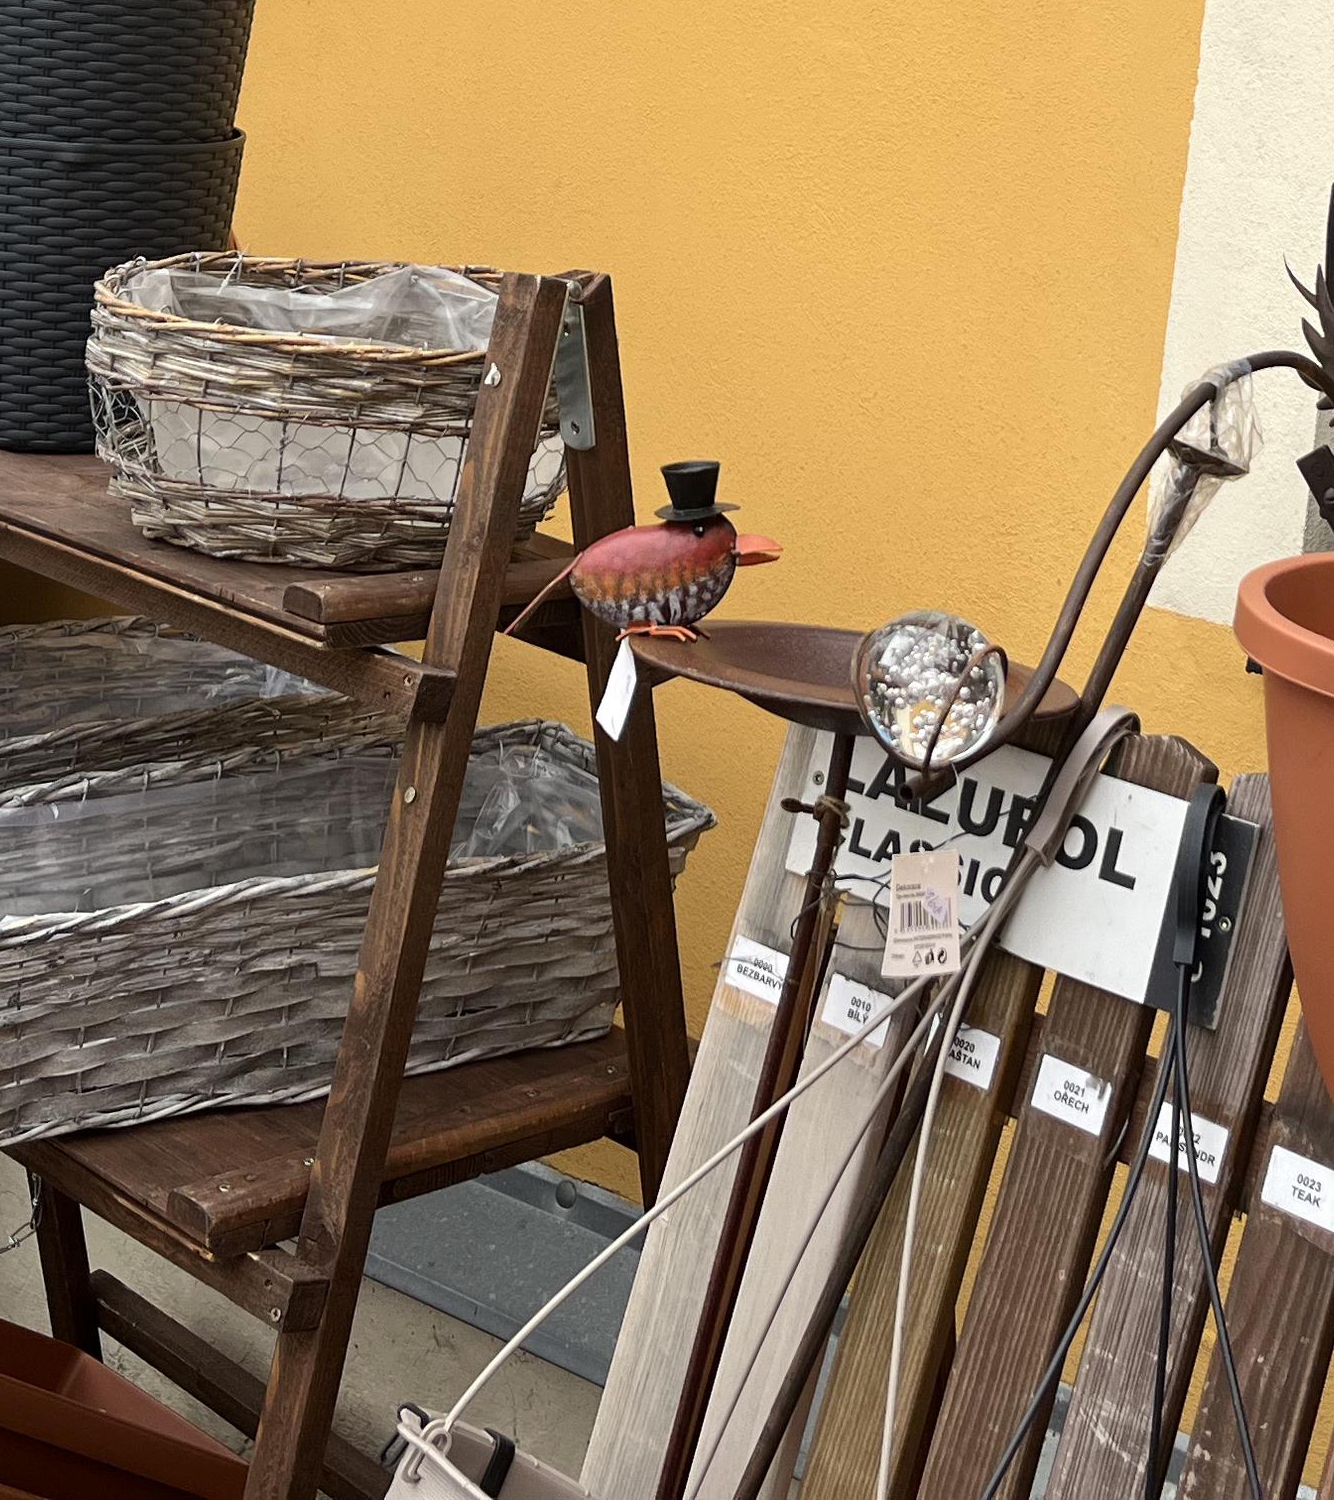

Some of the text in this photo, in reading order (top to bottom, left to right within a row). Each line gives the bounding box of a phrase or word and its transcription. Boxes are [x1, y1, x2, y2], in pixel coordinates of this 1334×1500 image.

[850, 996, 871, 1012] 0010
[948, 1049, 981, 1070] AŠTAN
[1063, 1080, 1086, 1097] 0021
[1053, 1088, 1089, 1115] OŘECH
[1296, 1173, 1322, 1192] 0023
[1291, 1185, 1321, 1209] TEAK
